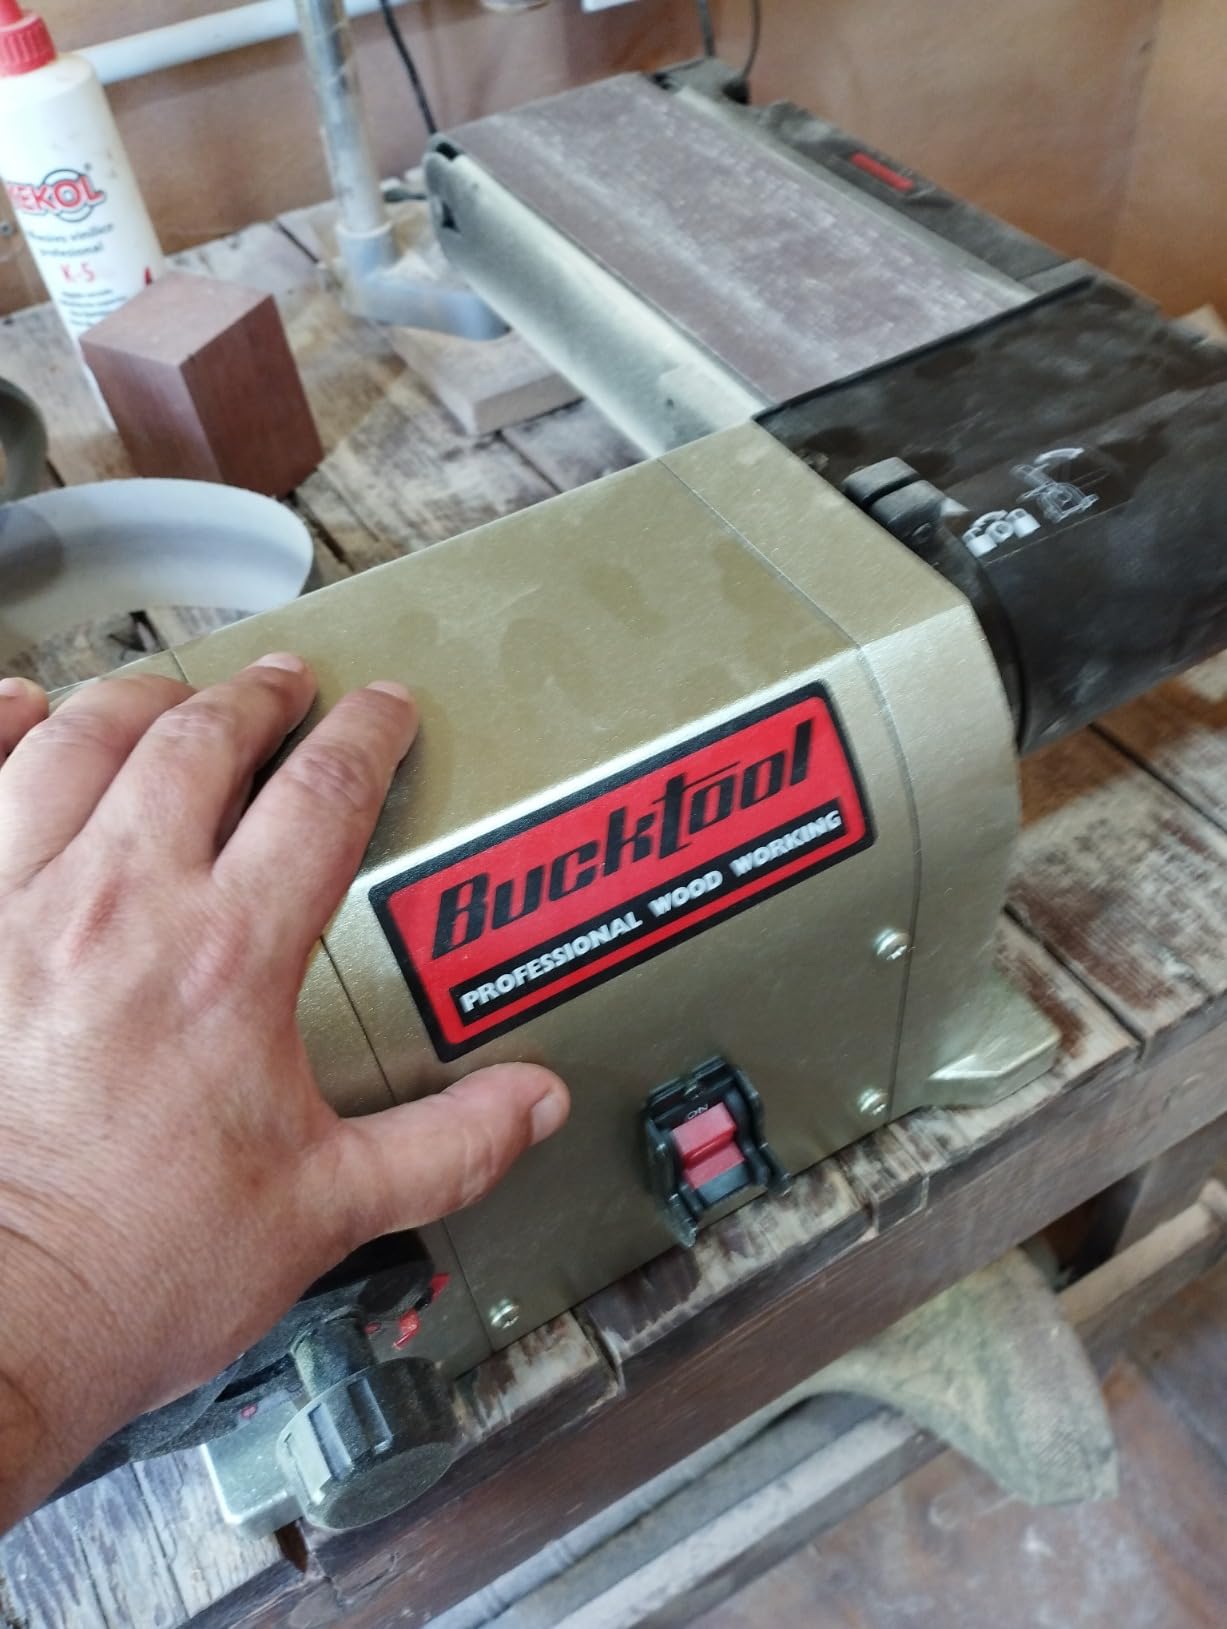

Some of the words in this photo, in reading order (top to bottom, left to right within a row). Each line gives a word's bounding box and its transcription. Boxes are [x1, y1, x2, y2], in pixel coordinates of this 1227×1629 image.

[431, 719, 814, 959] Bucktool
[458, 912, 643, 1013] PROFESSIONAL
[648, 870, 724, 918] WOOD
[729, 810, 843, 877] WORKING
